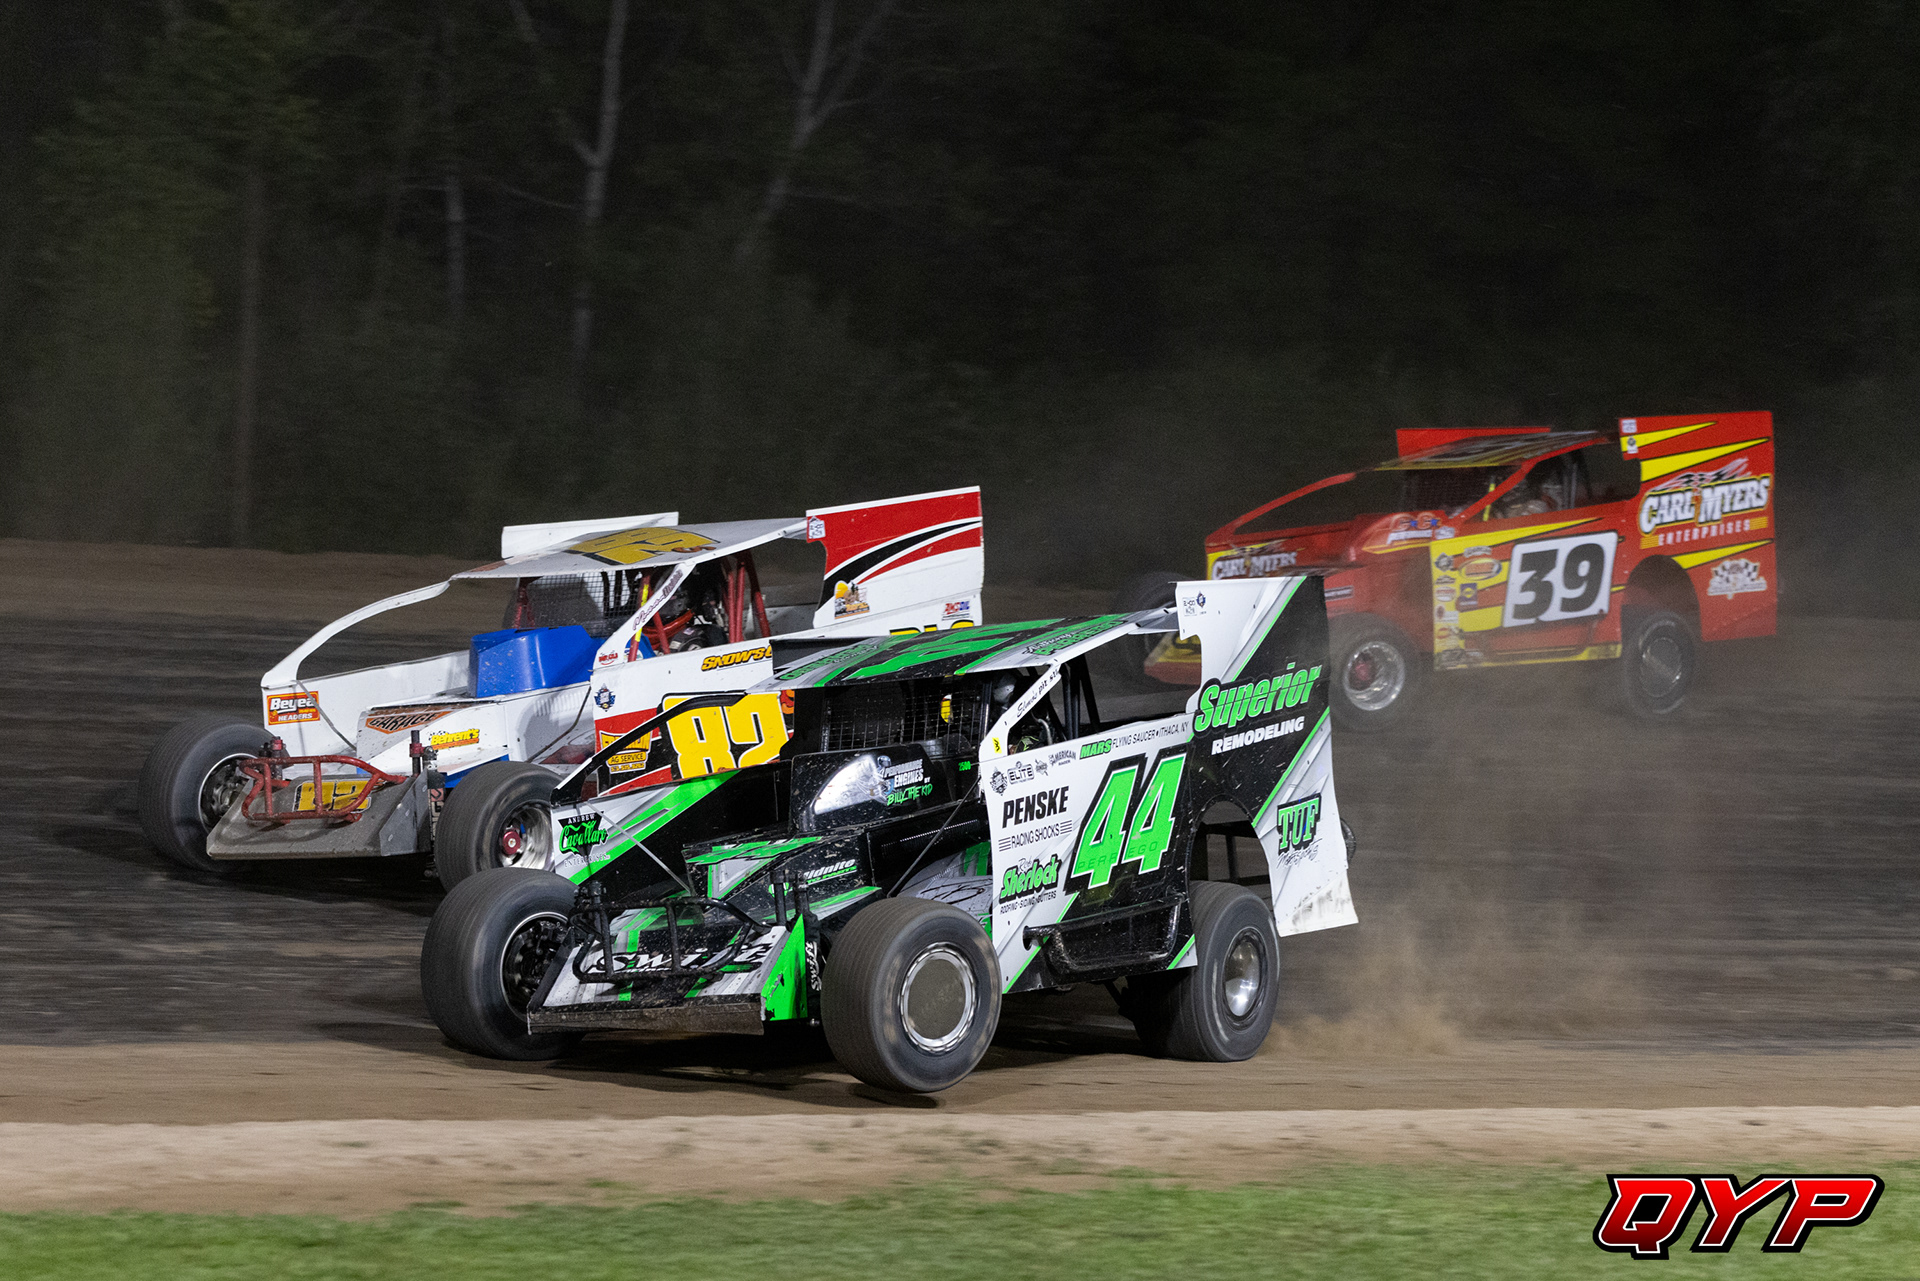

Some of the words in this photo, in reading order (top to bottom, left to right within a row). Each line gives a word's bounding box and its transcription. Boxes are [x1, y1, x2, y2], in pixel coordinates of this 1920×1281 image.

[1640, 488, 1695, 534] CARL
[1698, 477, 1772, 524] MYERS
[1658, 519, 1750, 546] ENTERPRISES
[1512, 543, 1605, 620] 39
[1194, 662, 1323, 732] Superior
[278, 713, 313, 721] HEADERS
[431, 728, 480, 746] Behrent's
[663, 692, 789, 779] 82
[1080, 738, 1113, 759] MARS
[1112, 736, 1132, 748] FLYING
[1132, 730, 1155, 744] SAUCER
[1211, 716, 1305, 755] REMODELING
[621, 753, 643, 763] SERVICE
[894, 769, 924, 788] ENGINES
[921, 784, 933, 797] KID
[567, 813, 596, 825] ANDREW
[1002, 786, 1069, 829] PENSKE
[1069, 750, 1189, 891] 44
[1011, 831, 1034, 850] RACING
[1034, 825, 1060, 842] SHOCKS
[1278, 797, 1320, 850] TUF
[1000, 855, 1060, 899] Sherlock
[1037, 890, 1057, 904] GUTTERS
